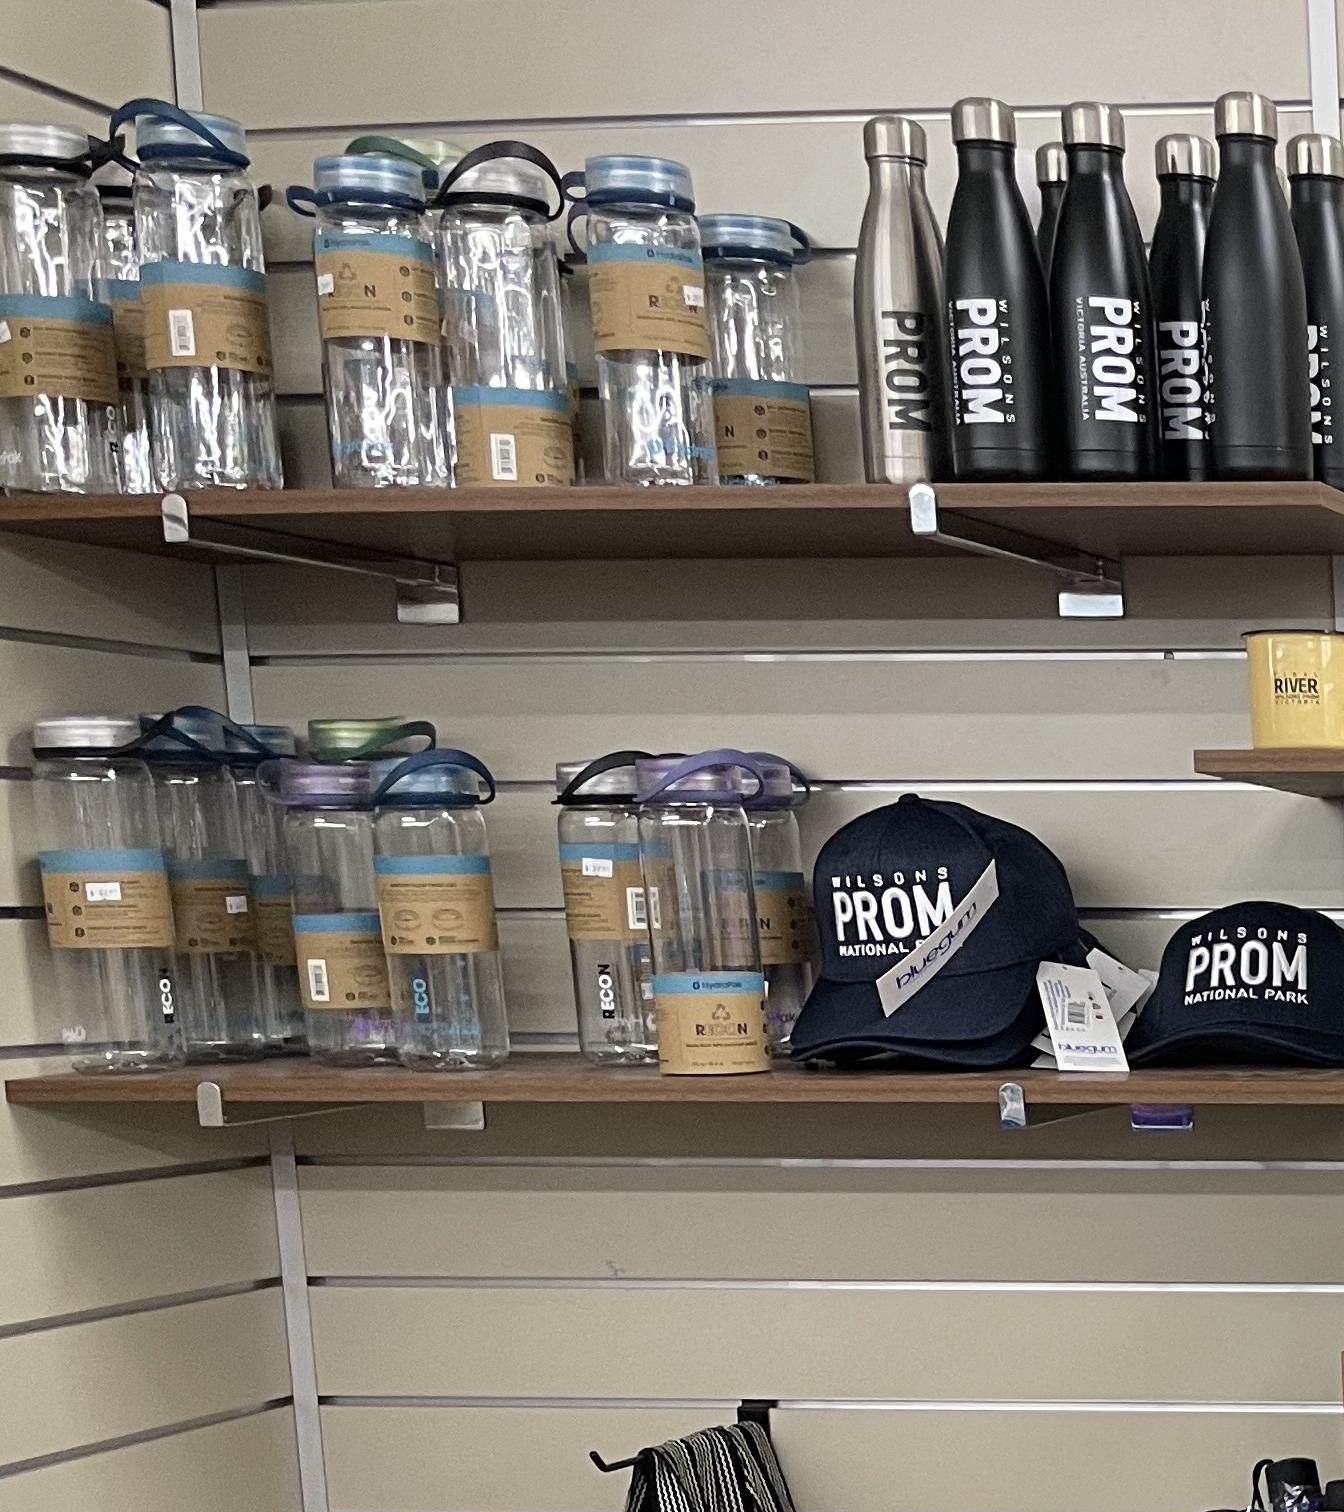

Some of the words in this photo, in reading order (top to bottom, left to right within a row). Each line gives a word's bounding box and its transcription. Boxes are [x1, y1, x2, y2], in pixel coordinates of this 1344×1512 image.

[1076, 296, 1086, 352] VICTORIA
[882, 310, 932, 433] PROM
[956, 298, 1005, 424] PROM
[999, 300, 1015, 424] WILSONS
[1078, 355, 1089, 421] AUSTRALIA
[1089, 296, 1139, 422] PROM
[1159, 321, 1204, 440] PROM
[1319, 325, 1332, 444] WILSONS
[1274, 677, 1318, 694] RIVER
[832, 866, 949, 888] WILSONS
[832, 881, 955, 941] PROM
[1191, 926, 1307, 946] WILSONS
[839, 941, 909, 957] NATIONAL
[895, 902, 977, 990] bluegum
[1185, 940, 1307, 992] PROM
[597, 964, 616, 1020] RECON
[1184, 988, 1258, 1006] NATIONAL
[1264, 988, 1309, 1005] PARK
